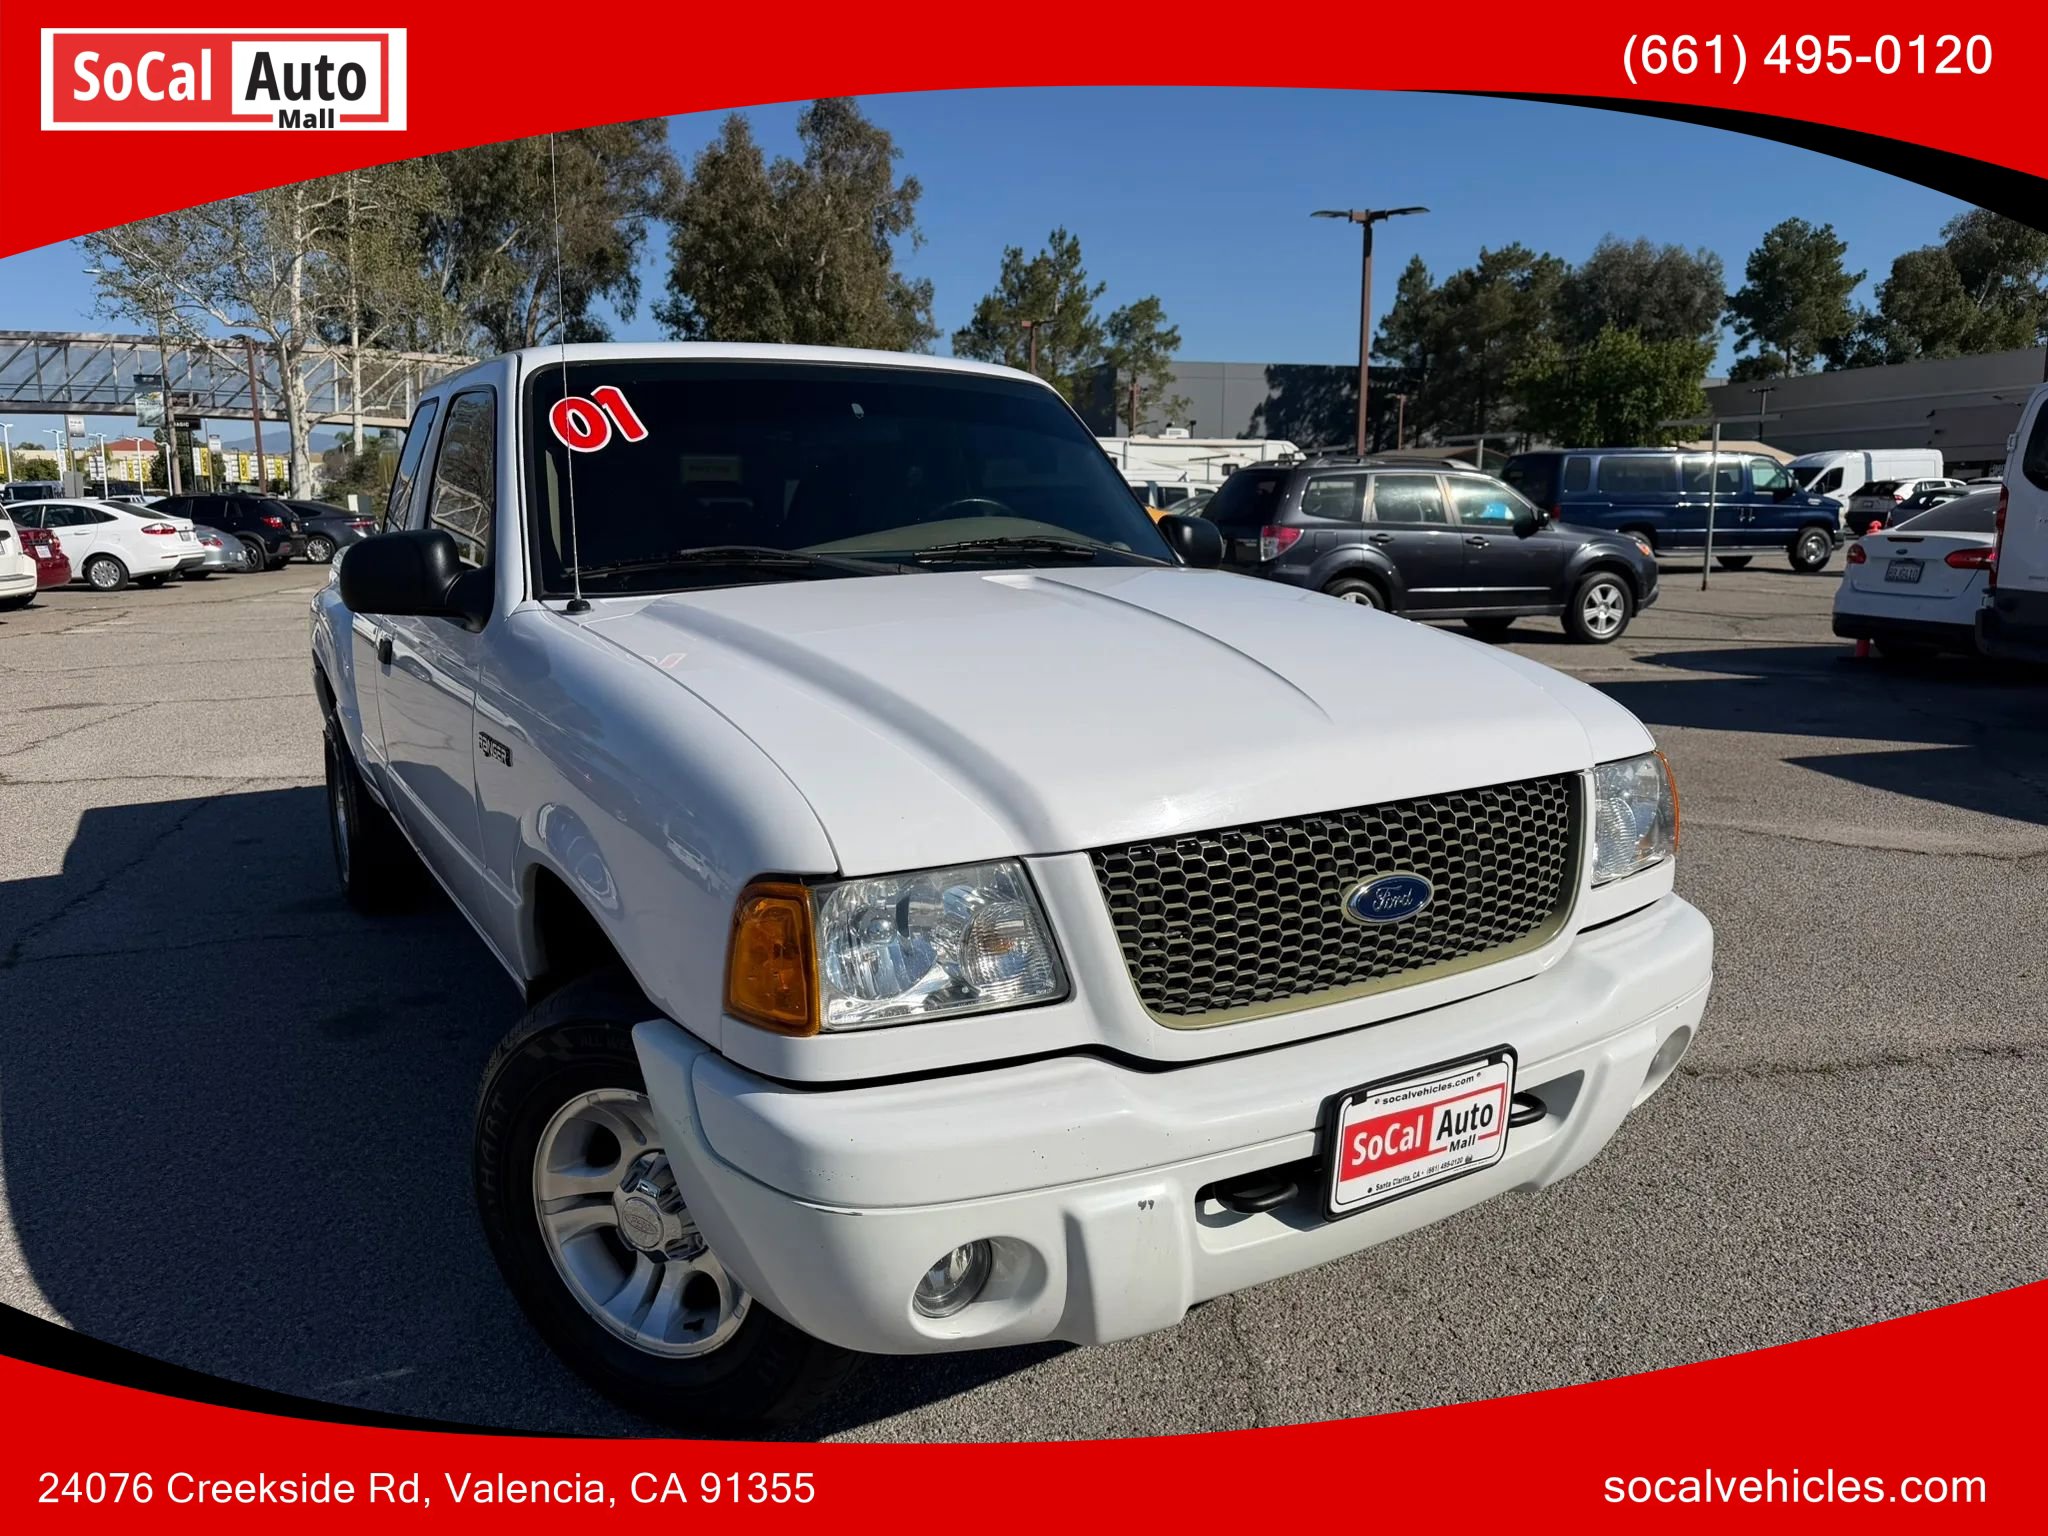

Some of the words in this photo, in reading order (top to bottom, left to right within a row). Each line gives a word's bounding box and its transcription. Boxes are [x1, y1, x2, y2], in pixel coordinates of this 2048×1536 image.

[549, 385, 649, 453] 01
[1372, 885, 1413, 912] Ford
[1382, 1075, 1475, 1105] socalvehicles.com
[1352, 1114, 1424, 1166] SoCal
[1436, 1103, 1493, 1141] Auto
[1449, 1134, 1476, 1153] Mall
